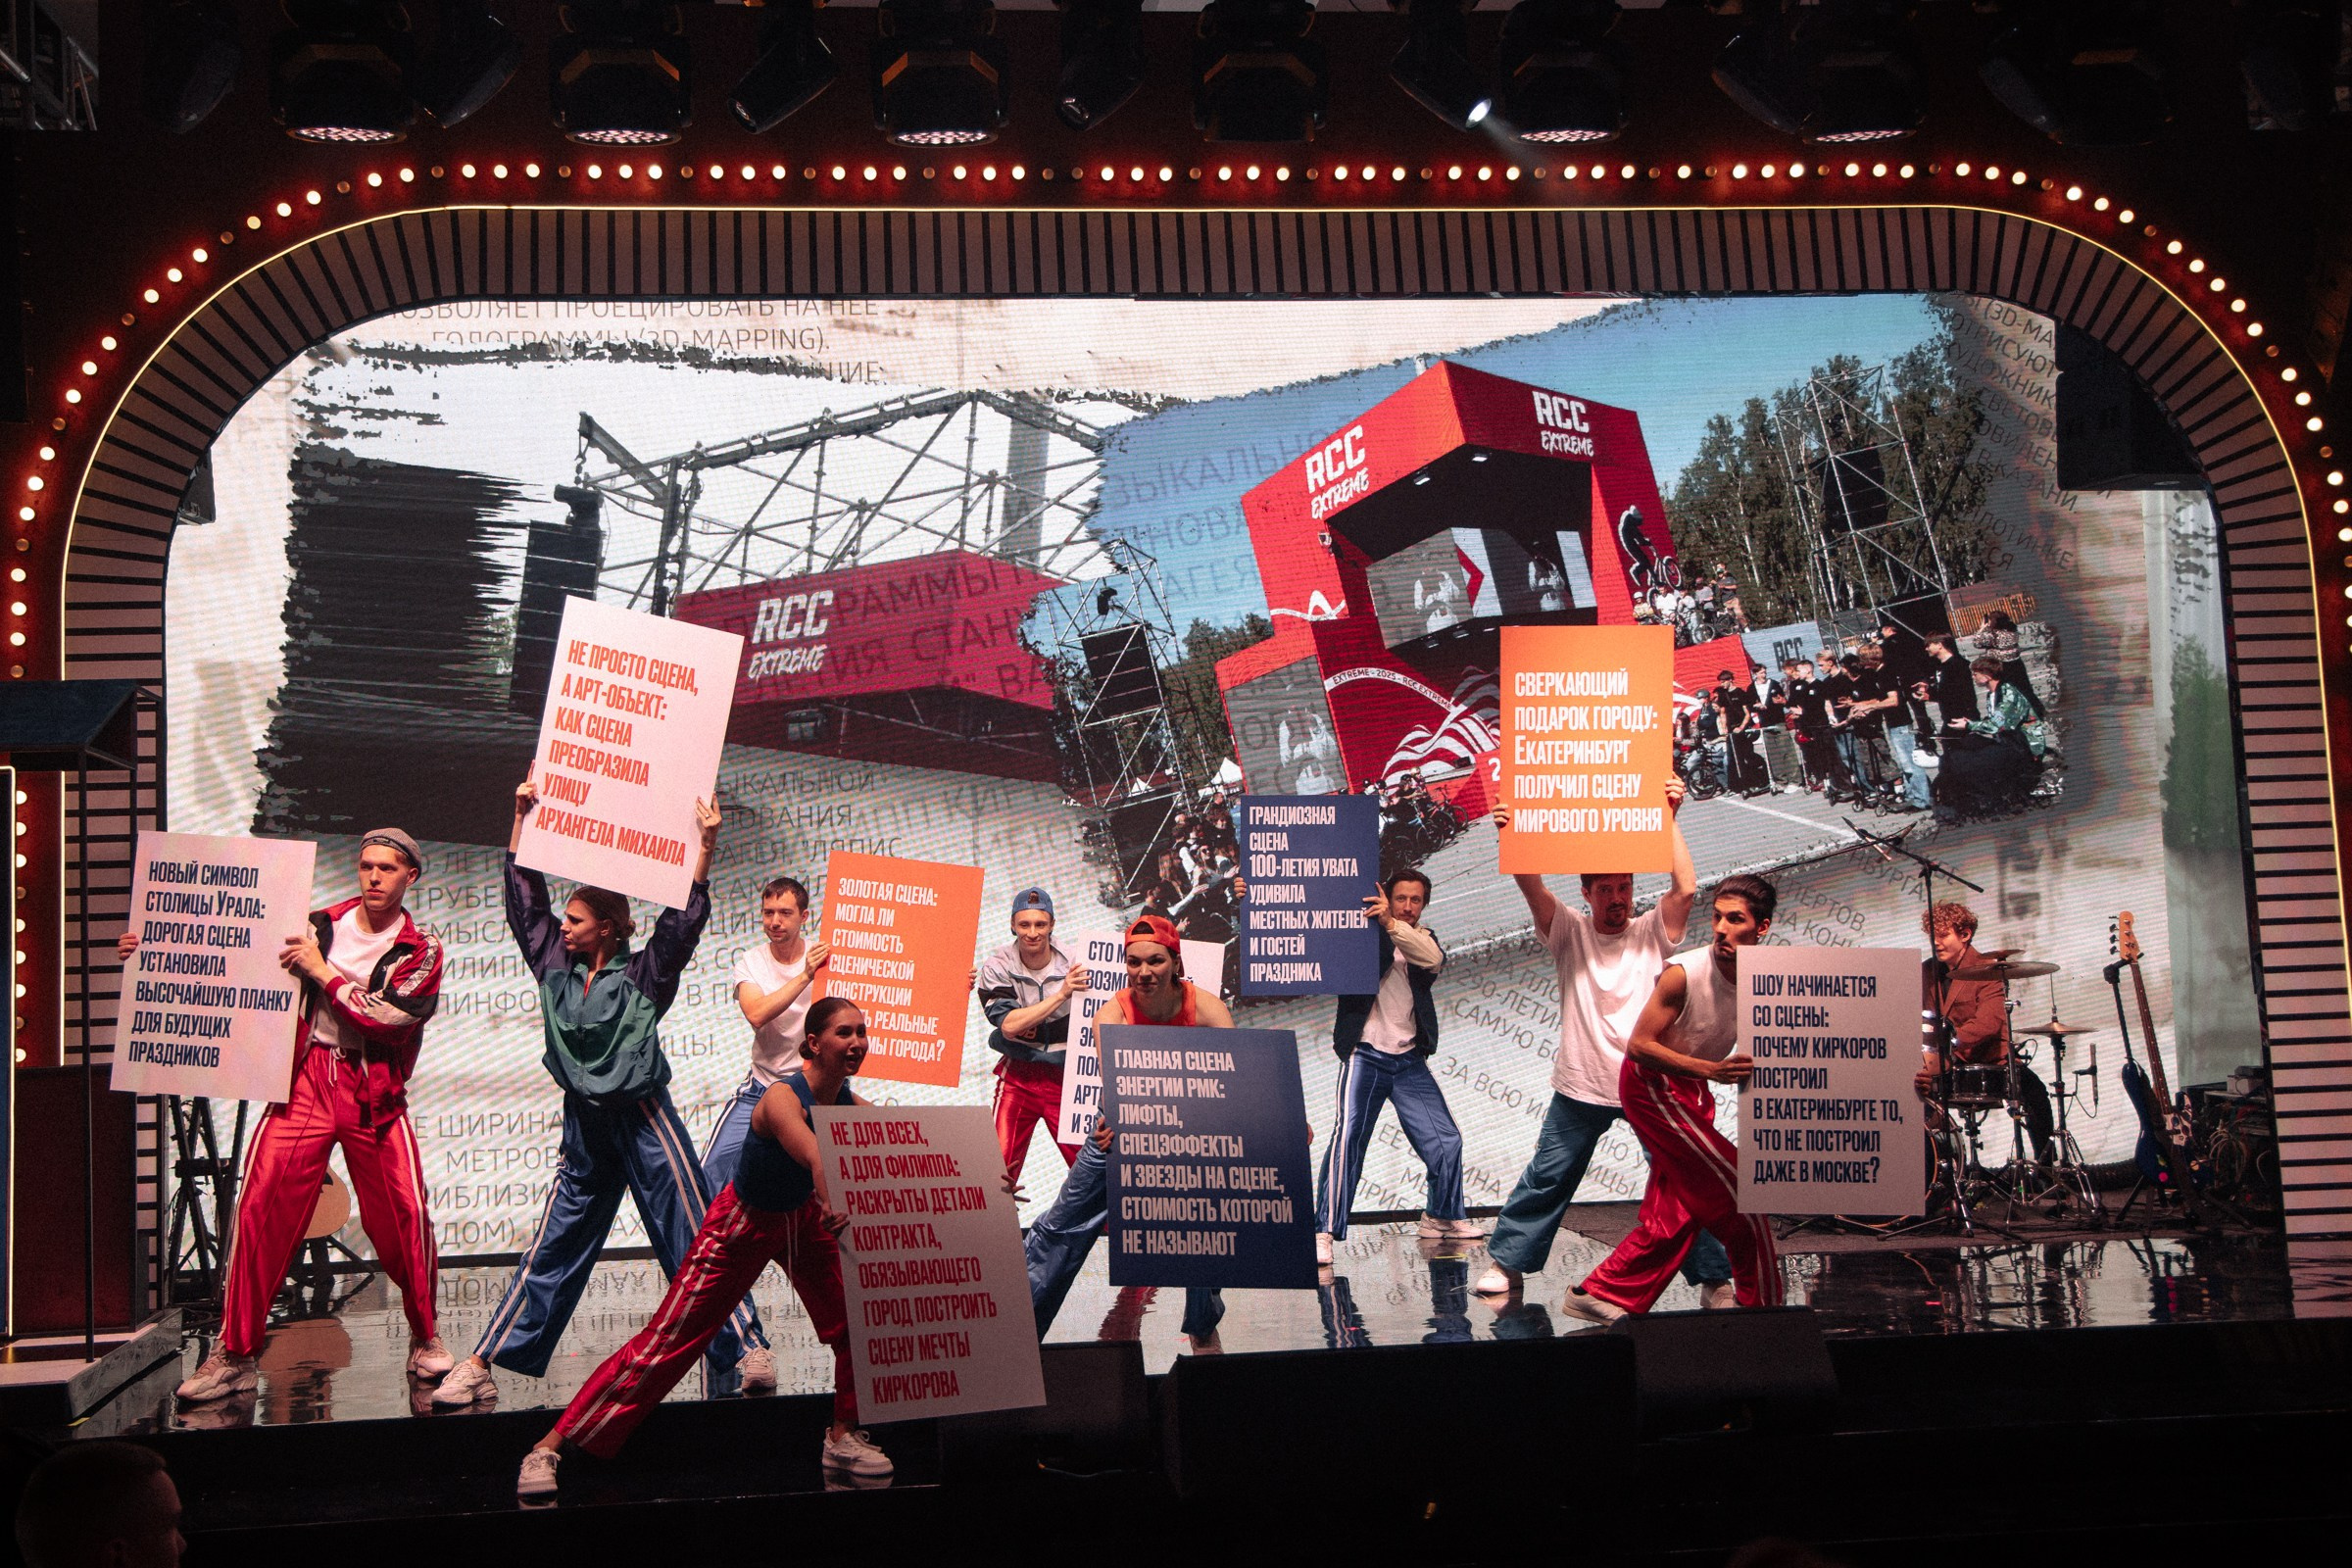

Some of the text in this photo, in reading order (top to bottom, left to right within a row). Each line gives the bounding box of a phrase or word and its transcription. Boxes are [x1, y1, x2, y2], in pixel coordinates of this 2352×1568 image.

[1532, 391, 1590, 433] RCC
[1541, 430, 1593, 457] EXTREME
[1305, 425, 1365, 493] RCC
[1311, 467, 1369, 519] EXTREME
[752, 590, 833, 645] RCC
[568, 640, 699, 696] НЕ ПРОСТО СЦЕНА,
[748, 644, 827, 682] EXTREME
[561, 673, 667, 720] А АРТ-ОБЪЕКТ:
[1515, 668, 1628, 698] СВЕРКАЮЩИЙ
[555, 707, 632, 747] КАК СЦЕНА
[1515, 706, 1658, 733] ПОДАРОК ГОРОДУ:
[549, 740, 650, 786] ПРЕОБРАЗИЛА
[543, 772, 591, 807] УЛИЦУ
[1514, 774, 1642, 801] ПОЛУЧИЛ СЦЕНУ
[1250, 806, 1336, 827] ГРАНДИОЗНАЯ
[1514, 808, 1662, 832] МИРОВОГО УРОВНЯ
[536, 807, 686, 866] АРХАНГЕЛА МИХАИЛА
[1250, 832, 1289, 853] СЦЕНА
[149, 860, 259, 888] НОВЫЙ СИМВОЛ
[1250, 854, 1358, 877] 100-ЛЕТИЯ УВАТА
[146, 891, 213, 917] СТОЛИЦЫ
[838, 878, 893, 902] ЗОЛОТАЯ
[896, 885, 939, 906] СЦЕНА:
[1250, 884, 1305, 906] УДИВИЛА
[835, 903, 875, 926] МОГЛА
[876, 908, 895, 927] ЛИ
[1250, 907, 1368, 930] МЕСТНЫХ ЖИТЕЛЕЙ
[142, 921, 251, 949] ДОРОГАЯ СЦЕНА
[832, 929, 904, 955] СТОИМОСТЬ
[1250, 934, 1305, 956] И ГОСТЕЙ
[139, 951, 226, 977] УСТАНОВИЛА
[1089, 941, 1114, 962] СТО
[829, 953, 914, 981] СЦЕНИЧЕСКОЙ
[1250, 962, 1322, 984] ПРАЗДНИКА
[135, 981, 293, 1011] ВЫСОЧАЙШУЮ ПЛАНКУ
[825, 979, 912, 1006] КОНСТРУКЦИИ
[1752, 974, 1877, 998] ШОУ НАЧИНАЕТСЯ
[131, 1011, 232, 1039] ДЛЯ БУДУЩИХ
[874, 1010, 939, 1036] РЕАЛЬНЫЕ
[1752, 1005, 1829, 1030] СО СЦЕНЫ:
[128, 1041, 220, 1067] ПРАЗДНИКОВ
[889, 1039, 946, 1062] ГОРОДА?
[1114, 1049, 1236, 1073] ГЛАВНАЯ СЦЕНА
[1752, 1036, 1887, 1059] ПОЧЕМУ КИРКОРОВ
[1116, 1076, 1225, 1099] ЭНЕРГИИ РМК:
[1442, 1056, 1522, 1108] ЗА ВСЮ
[1752, 1067, 1828, 1090] ПОСТРОИЛ
[1118, 1103, 1183, 1128] ЛИФТЫ,
[1753, 1099, 1763, 1119] В
[1767, 1099, 1877, 1121] ЕКАТЕРИНБУРГЕ
[1881, 1100, 1903, 1124] ТО,
[831, 1121, 929, 1149] НЕ ДЛЯ ВСЕХ,
[1119, 1133, 1244, 1158] СПЕЦЭФФЕКТЫ
[1753, 1129, 1881, 1152] ЧТО НЕ ПОСТРОИЛ
[840, 1153, 961, 1183] А ДЛЯ ФИЛИППА:
[1120, 1163, 1285, 1194] И ЗВЕЗДЫ НА СЦЕНЕ,
[1754, 1156, 1881, 1185] ДАЖЕ В МОСКВЕ?
[846, 1187, 988, 1216] РАСКРЫТЫ ДЕТАЛИ
[1122, 1196, 1294, 1223] СТОИМОСТЬ КОТОРОЙ
[853, 1223, 942, 1251] КОНТРАКТА,
[1122, 1230, 1237, 1255] НЕ НАЗЫВАЮТ
[858, 1256, 982, 1290] ОБЯЗЫВАЮЩЕГО
[863, 1292, 998, 1328] ГОРОД ПОСТРОИТЬ
[867, 1331, 970, 1367] СЦЕНУ МЕЧТЫ
[872, 1369, 960, 1404] КИРКОРОВА
